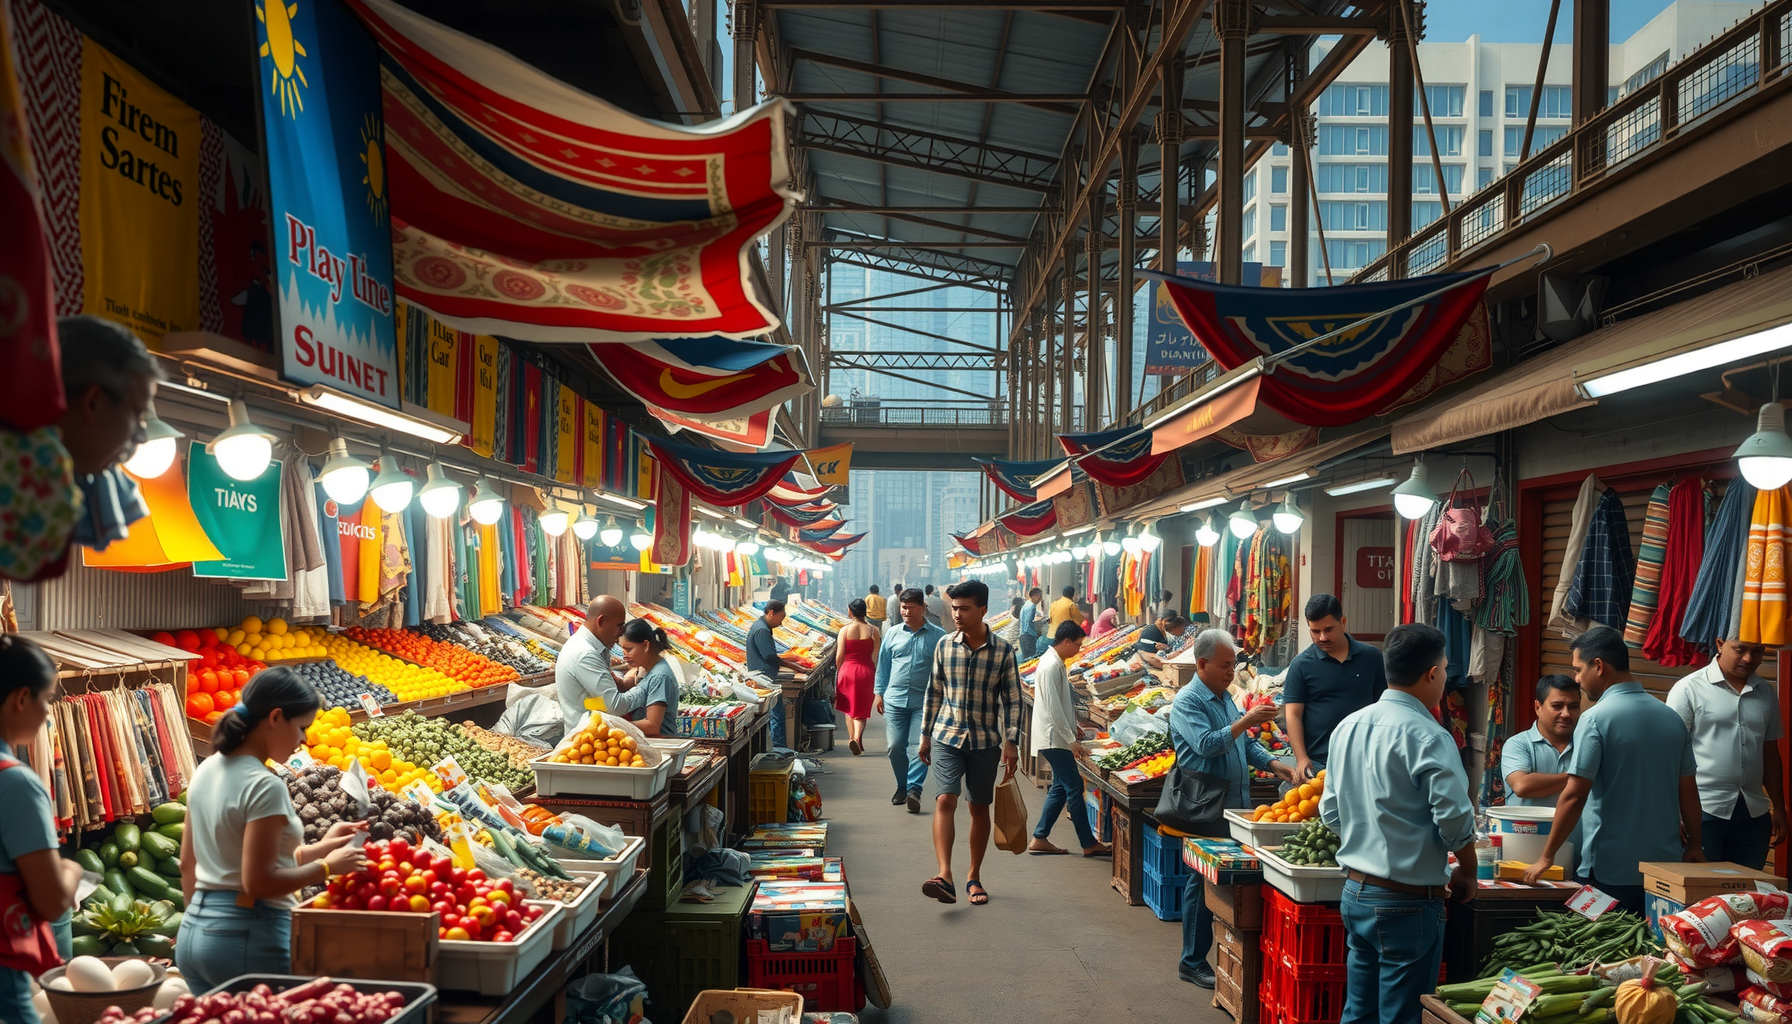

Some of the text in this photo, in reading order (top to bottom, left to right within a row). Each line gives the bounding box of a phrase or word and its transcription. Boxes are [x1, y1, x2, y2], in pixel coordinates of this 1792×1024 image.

[101, 71, 178, 158] Firem
[101, 126, 183, 206] Sartes
[286, 211, 346, 304] Play
[214, 487, 257, 513] TIAYS
[817, 460, 841, 475] CK
